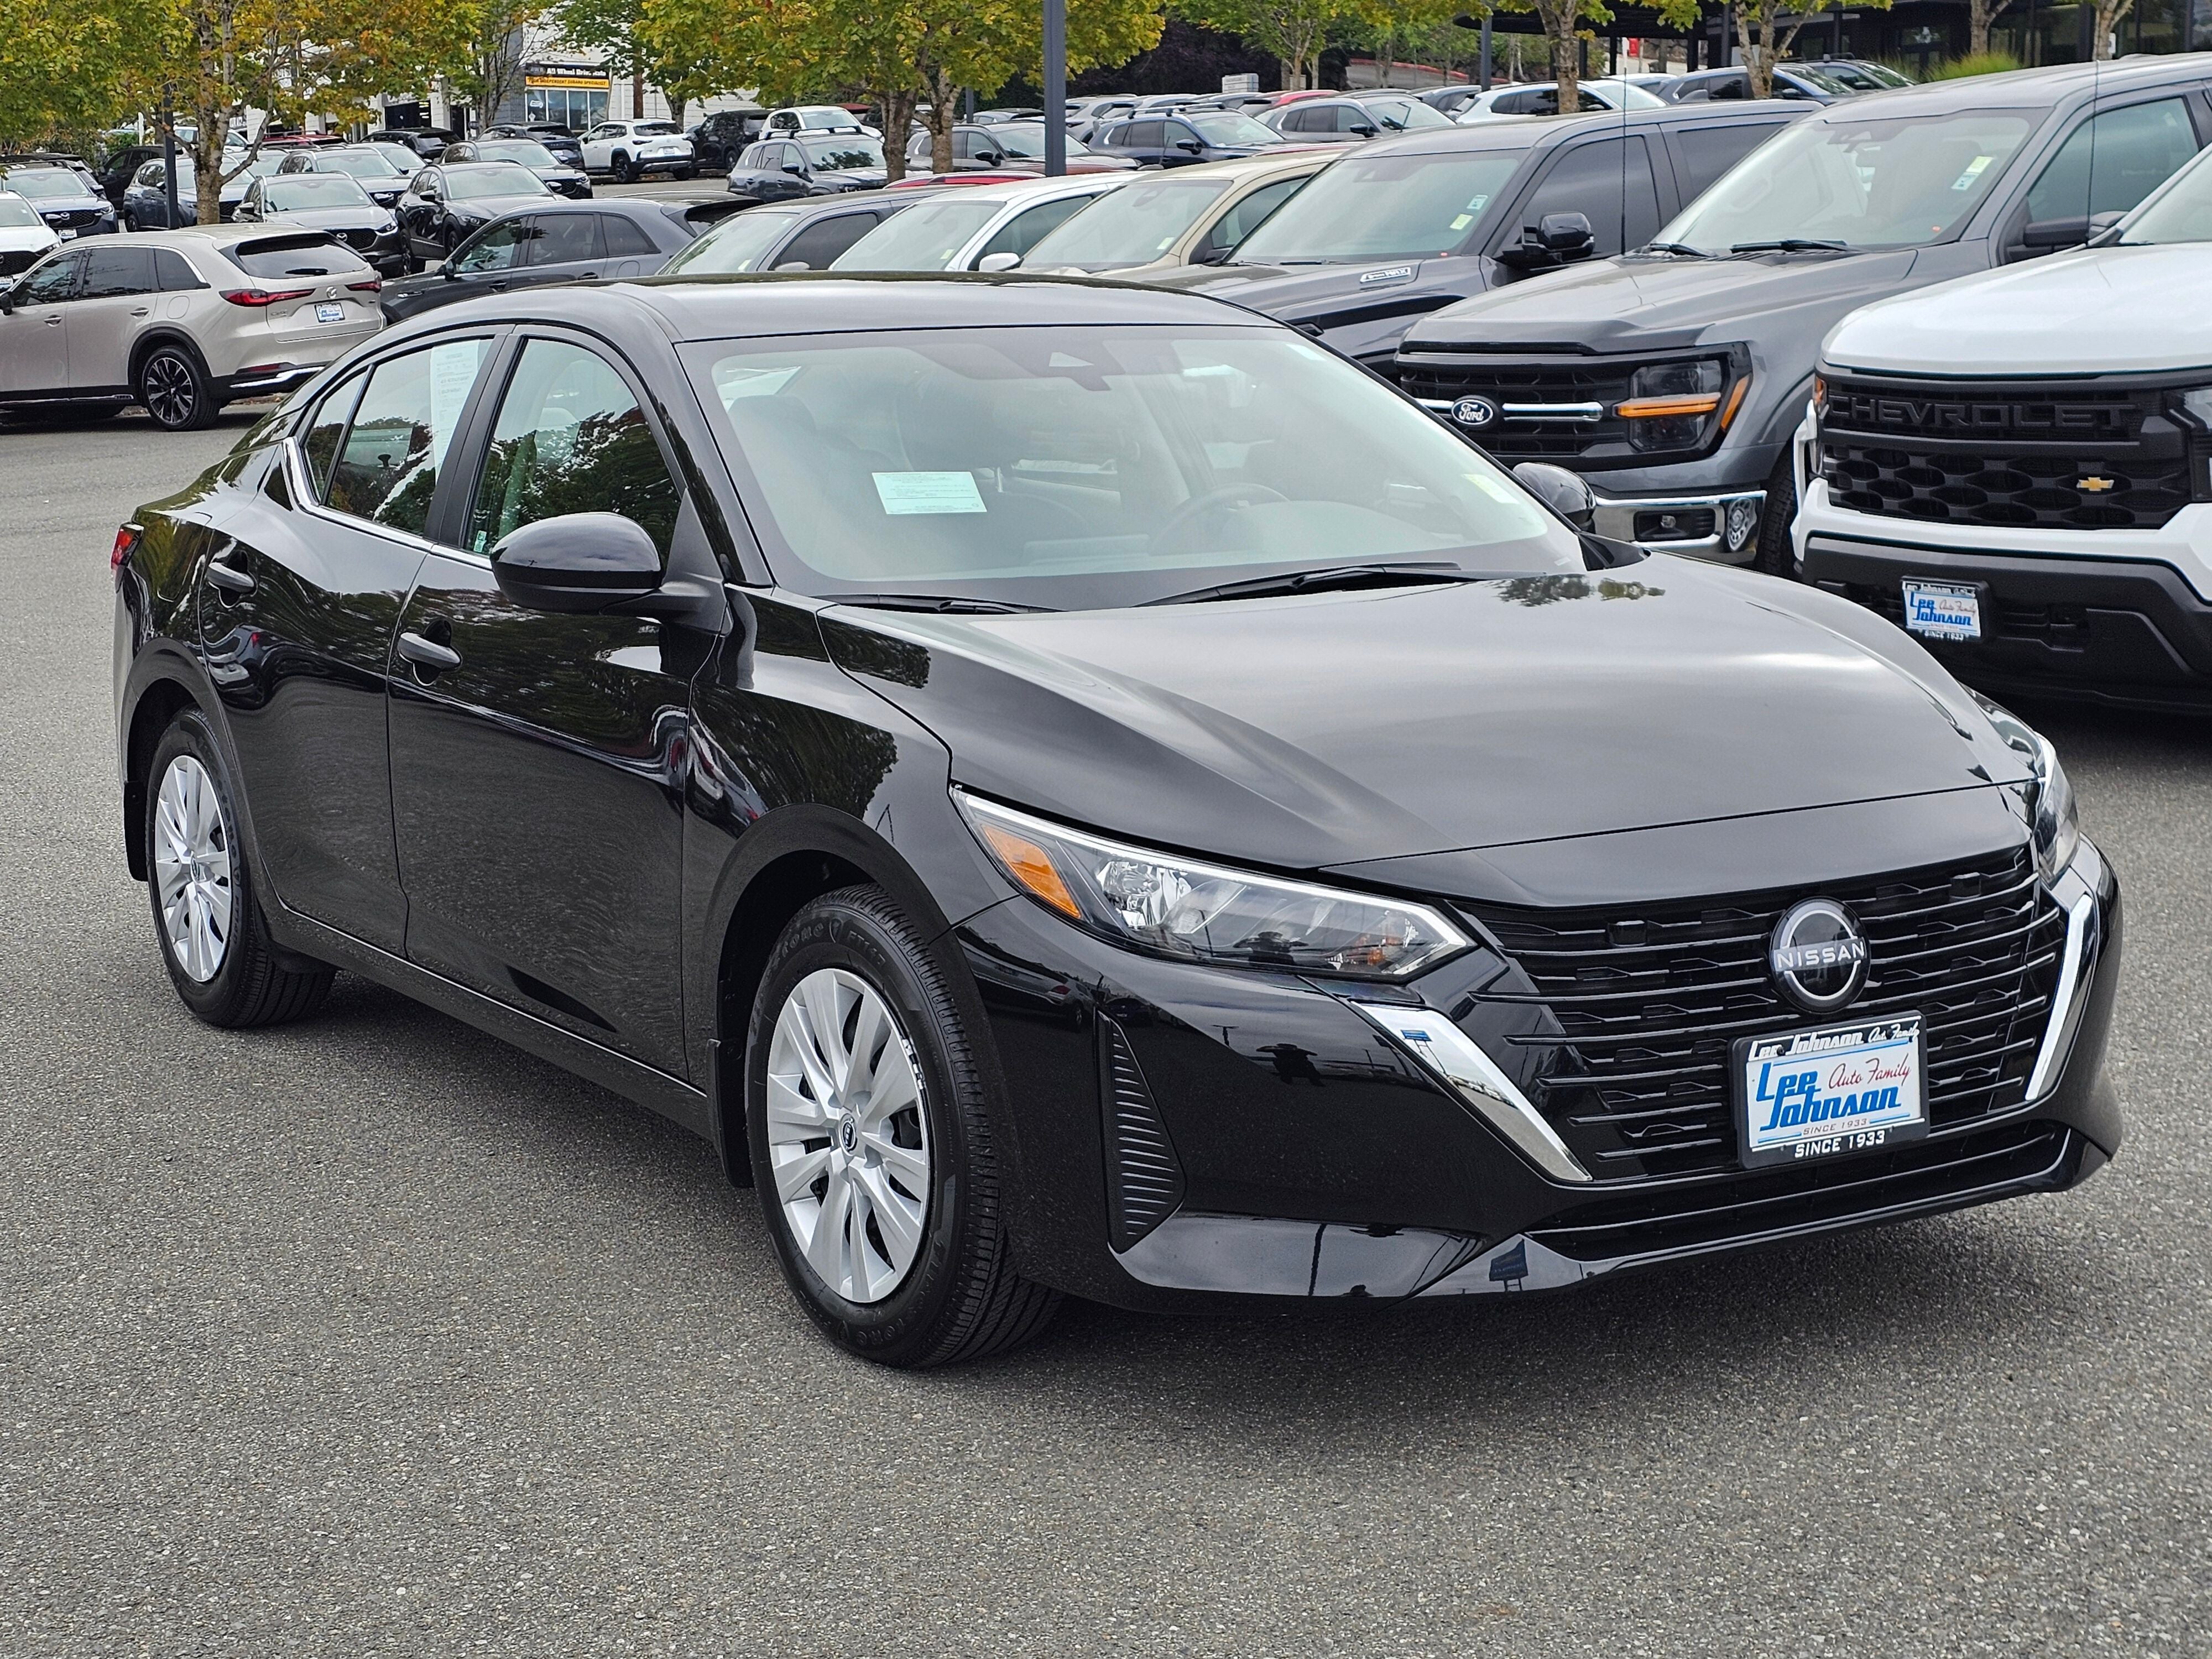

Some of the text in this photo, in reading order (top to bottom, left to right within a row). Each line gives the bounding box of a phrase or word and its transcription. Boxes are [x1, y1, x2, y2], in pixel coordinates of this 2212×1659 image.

[1459, 403, 1484, 421] Ford
[1829, 395, 2136, 428] CHEVROLET
[1910, 592, 1937, 609] Lee
[1913, 607, 1973, 626] Johnson
[1924, 629, 1944, 639] SINCE
[1777, 941, 1864, 968] NISSAN
[1786, 1032, 1864, 1055] Johnson
[1756, 1062, 1818, 1102] Lee
[1829, 1053, 1911, 1089] Auto Family
[1759, 1086, 1902, 1131] Johnson
[1803, 1118, 1867, 1135] SINCE 1933
[1794, 1130, 1886, 1158] SINCE 1933
